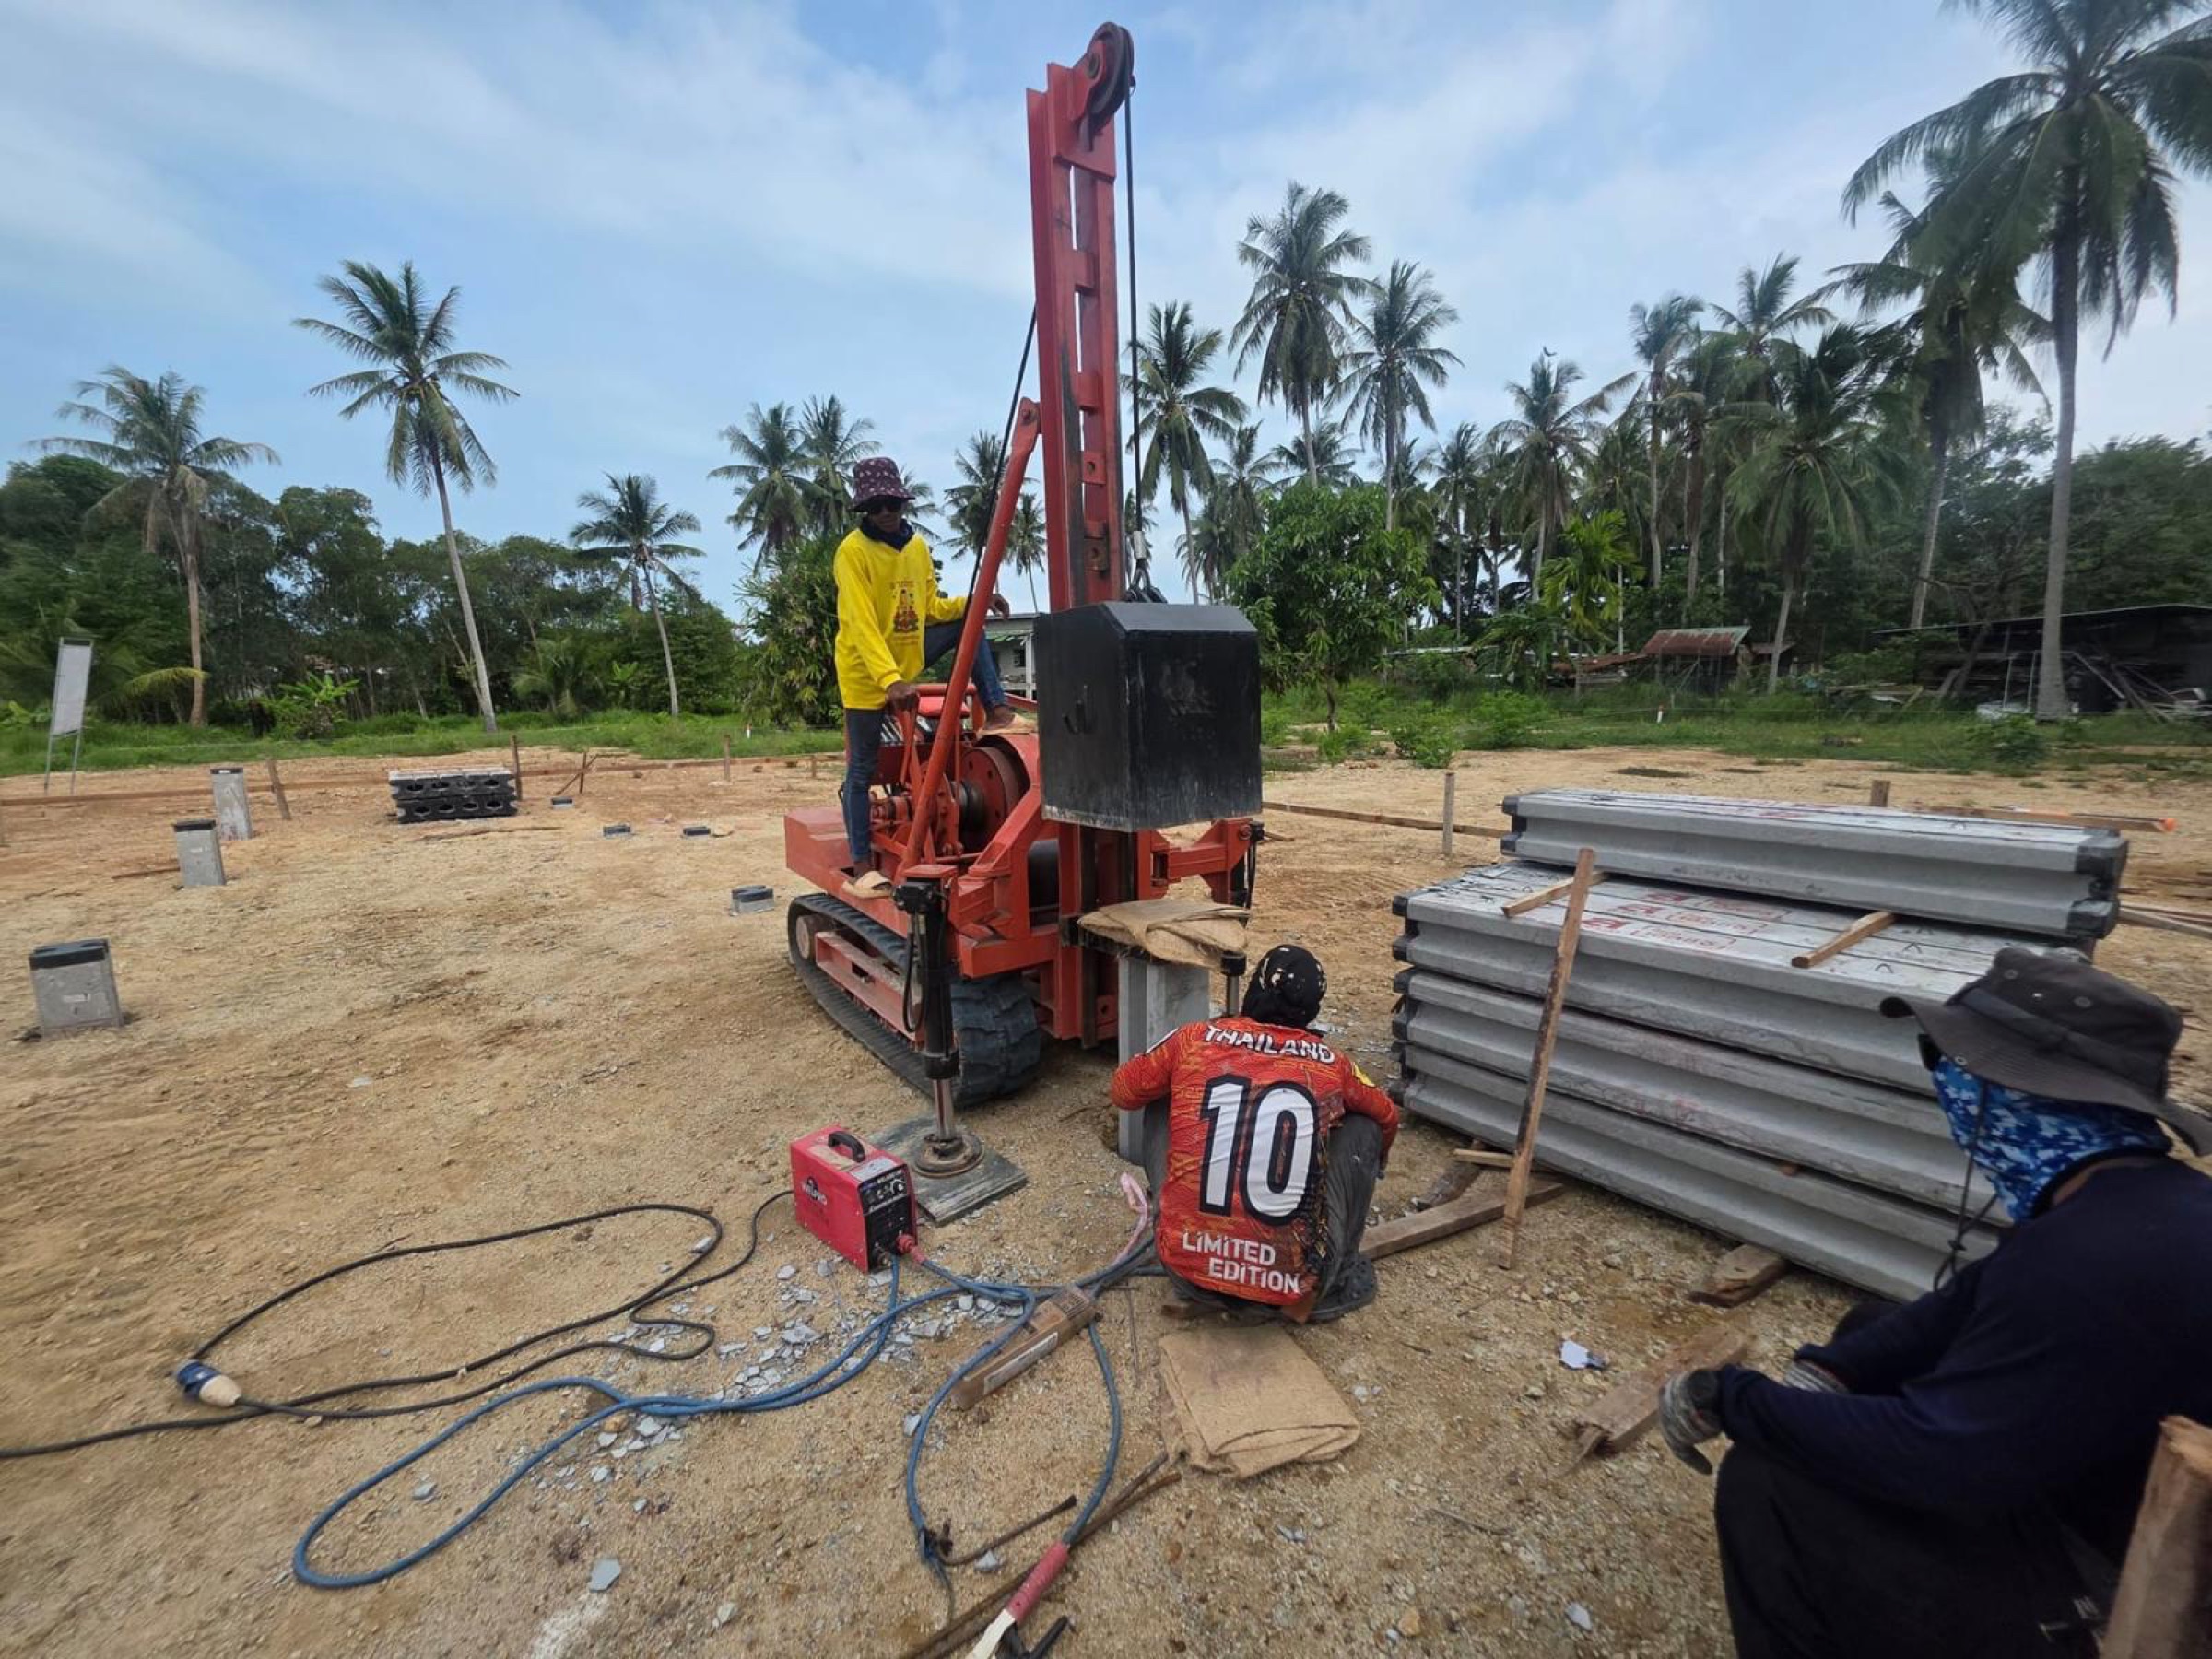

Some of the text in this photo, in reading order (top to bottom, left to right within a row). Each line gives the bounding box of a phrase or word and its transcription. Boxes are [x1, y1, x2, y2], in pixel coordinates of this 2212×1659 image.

[1204, 1025, 1335, 1063] THAILAND
[1202, 1076, 1317, 1223] 10
[1182, 1229, 1276, 1265] LIMITED
[1209, 1257, 1301, 1295] EDITION
